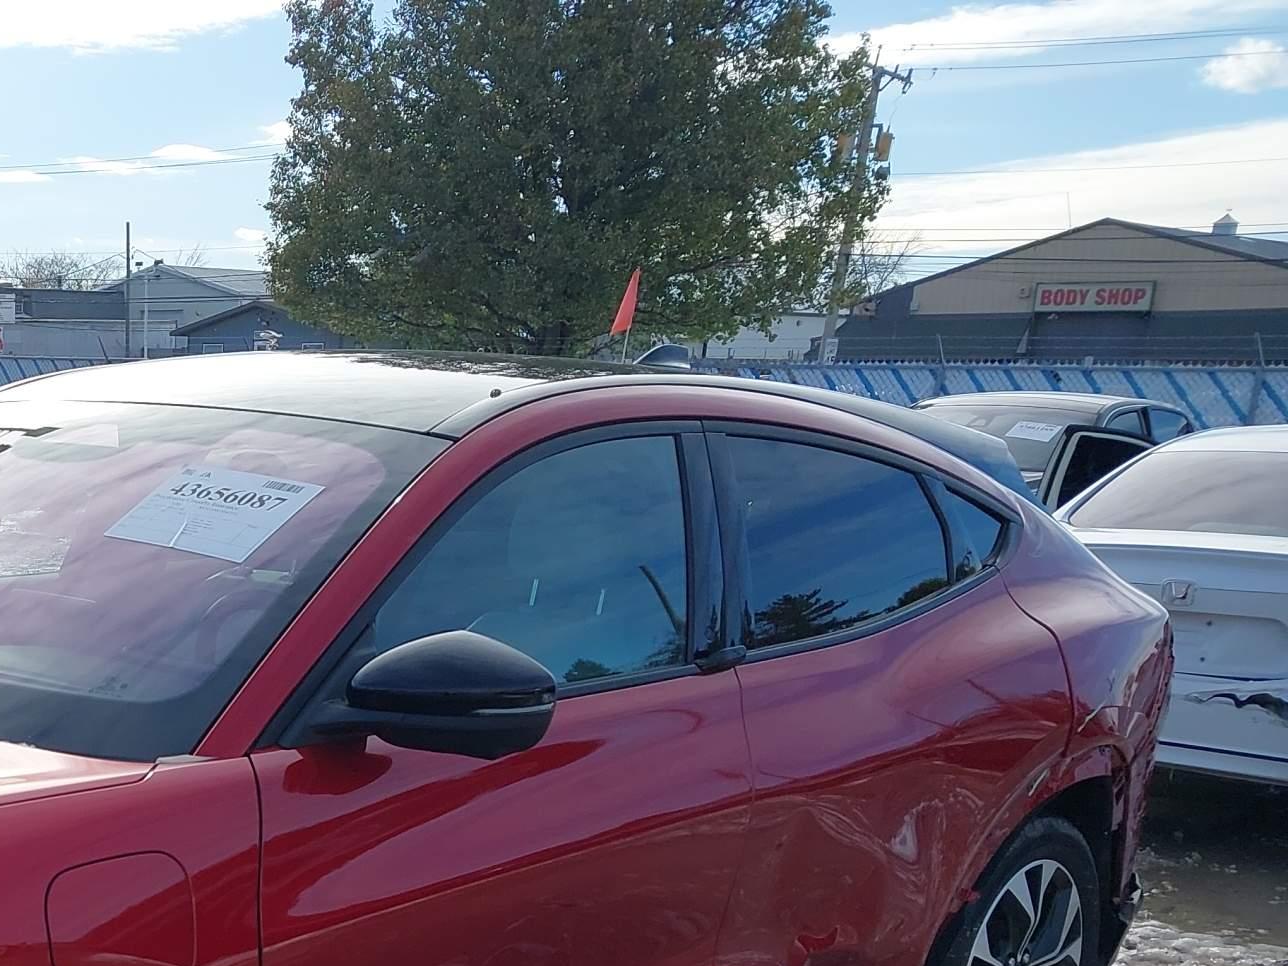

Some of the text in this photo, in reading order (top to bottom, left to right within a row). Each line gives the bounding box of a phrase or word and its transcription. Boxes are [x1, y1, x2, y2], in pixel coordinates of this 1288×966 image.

[1040, 288, 1147, 306] BODY SHOP
[169, 481, 289, 512] 43656087
